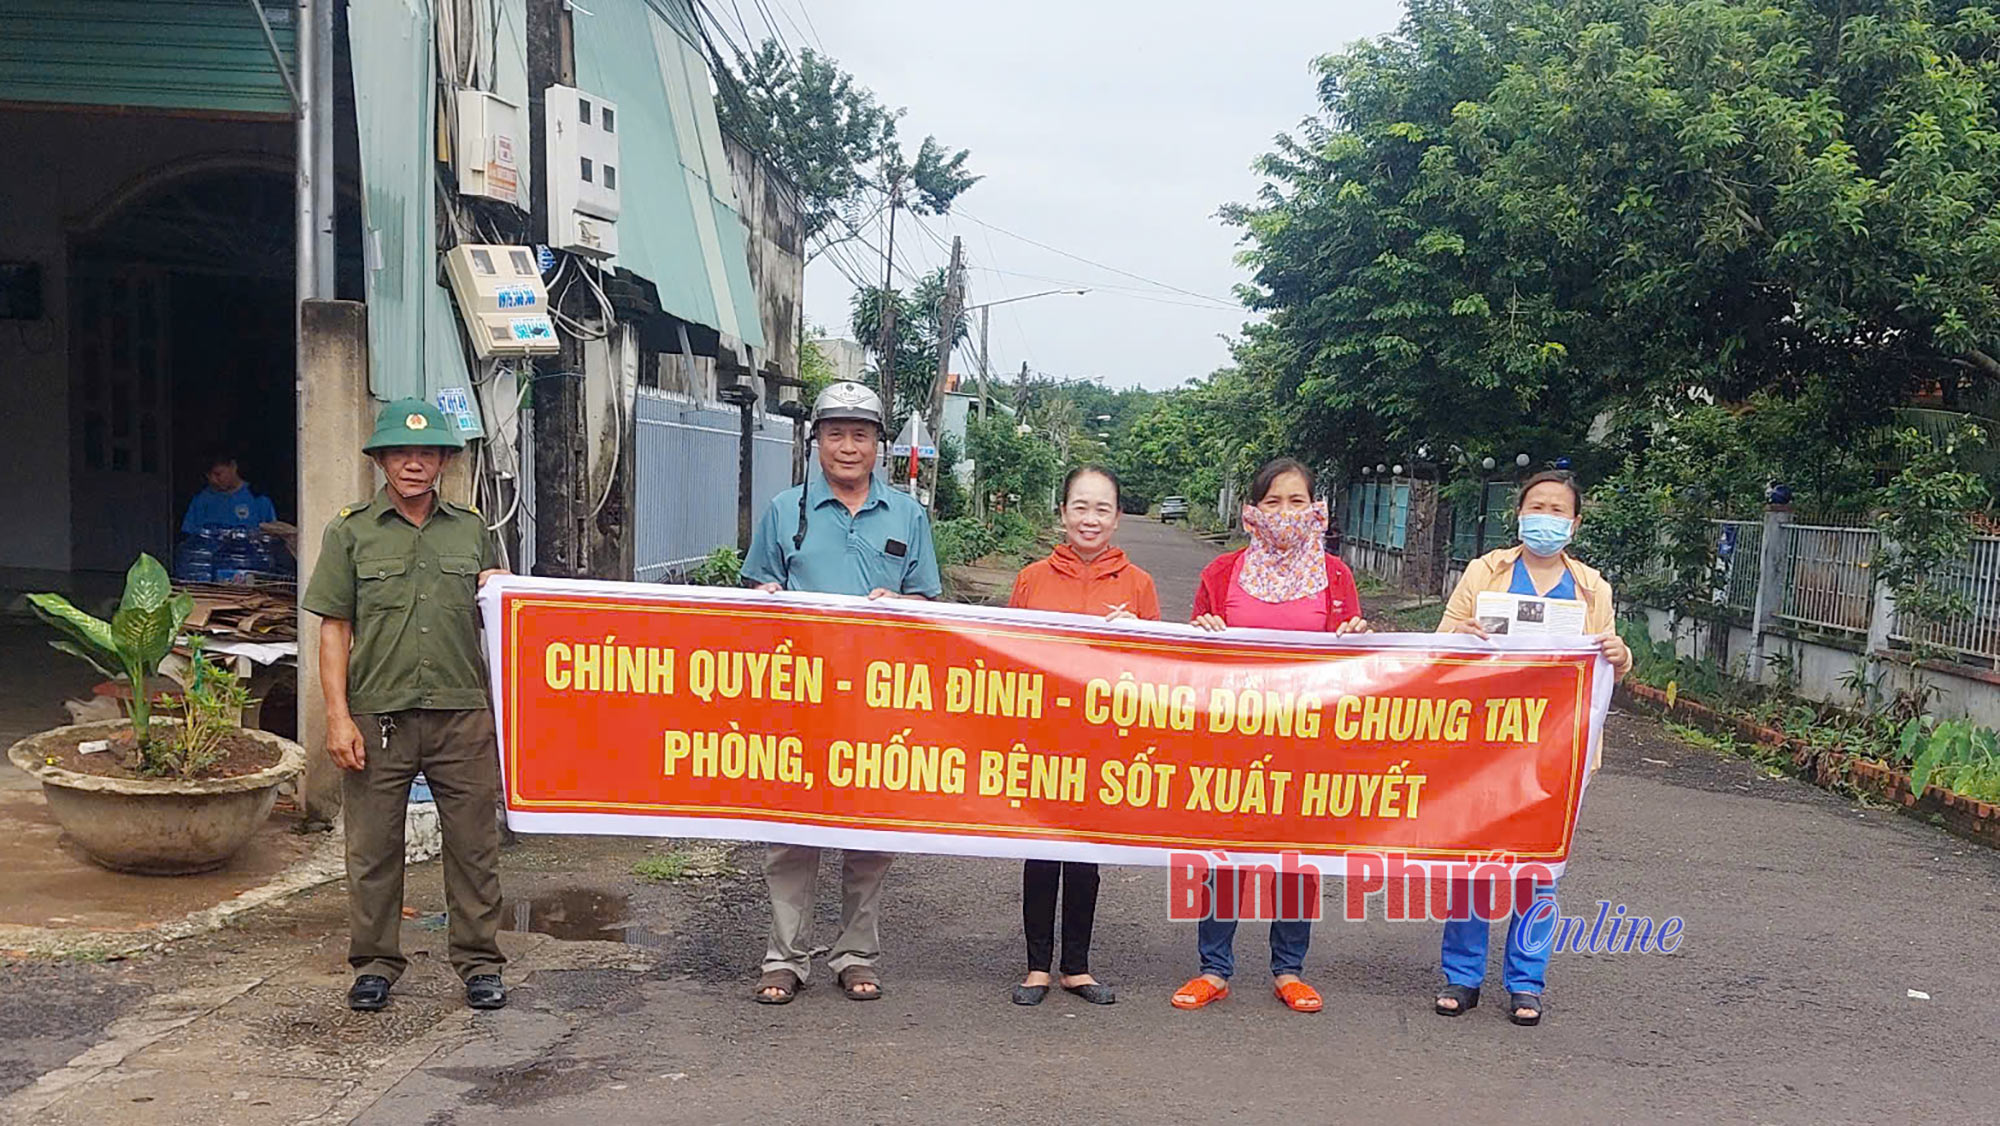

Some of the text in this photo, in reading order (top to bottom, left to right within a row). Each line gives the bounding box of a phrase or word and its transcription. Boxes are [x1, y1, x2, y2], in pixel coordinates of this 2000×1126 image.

[545, 635, 675, 694] CHÍNH
[689, 637, 824, 704] QUYỀN
[865, 660, 933, 712] GIA
[945, 659, 1044, 719] ĐÌNH
[1084, 676, 1195, 737] CỘNG
[1335, 695, 1472, 743] CHUNG
[1485, 697, 1548, 744] TAY
[664, 721, 1427, 819] PHÒNG, CHỐNG BỆNH SỐT XUẤT HUYẾT
